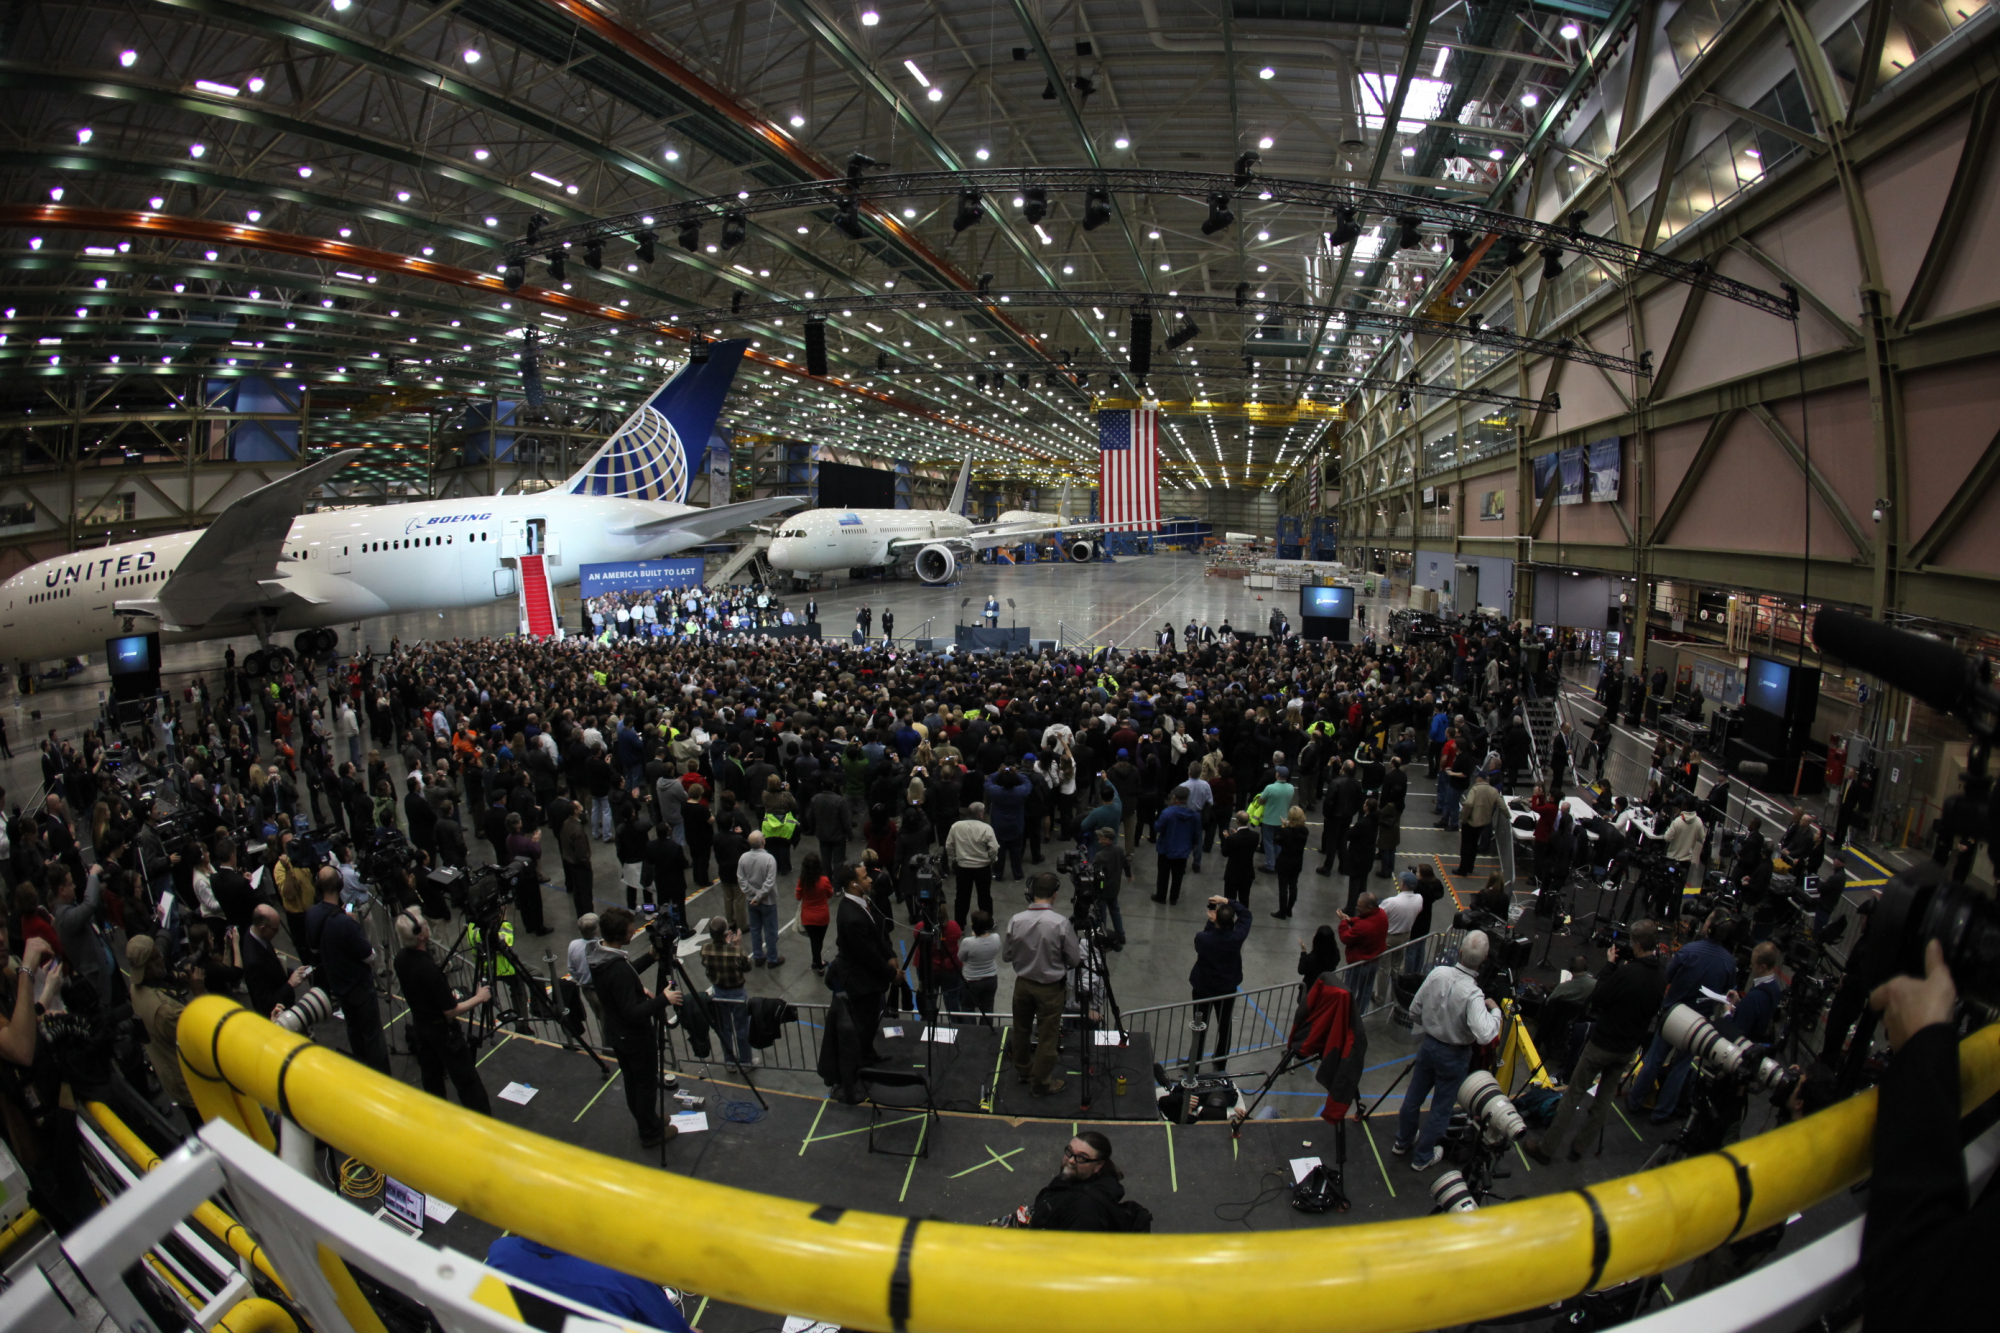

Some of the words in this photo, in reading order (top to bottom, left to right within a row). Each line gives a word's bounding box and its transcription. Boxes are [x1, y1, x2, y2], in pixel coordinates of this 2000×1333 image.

[426, 512, 493, 525] BOEING
[46, 551, 156, 588] UNITED
[588, 573, 600, 581] AN
[602, 571, 639, 580] AMERICA
[640, 569, 662, 577] BUILT
